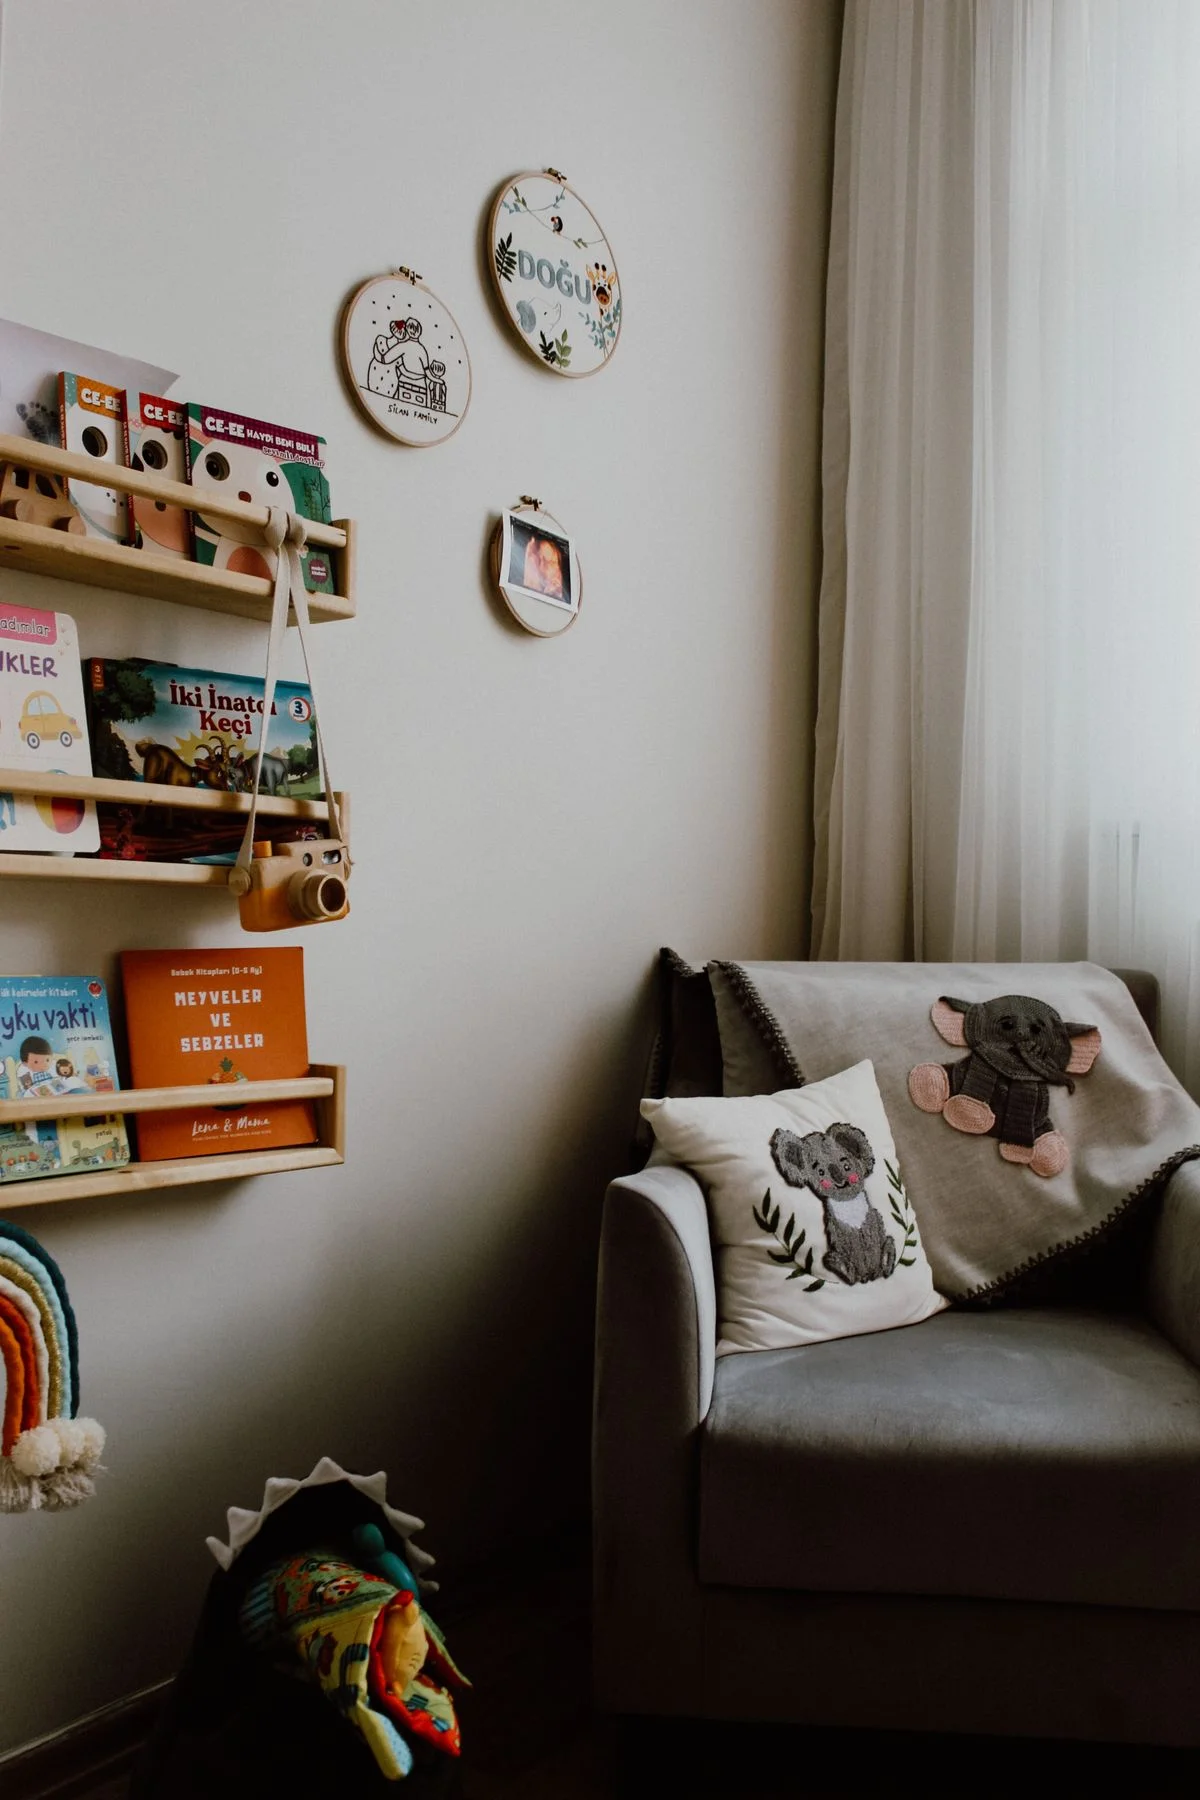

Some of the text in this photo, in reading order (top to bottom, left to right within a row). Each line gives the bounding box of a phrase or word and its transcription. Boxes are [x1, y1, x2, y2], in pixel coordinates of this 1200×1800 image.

[518, 249, 591, 304] DOĞU
[80, 388, 120, 412] CE-EE
[143, 403, 184, 426] CE-EE
[205, 416, 245, 438] CE-EE
[296, 442, 315, 455] BUL!
[169, 678, 203, 708] İki
[294, 700, 303, 714] 3
[199, 710, 252, 739] Keçi
[174, 988, 262, 1007] MEYVELER
[1, 1001, 96, 1040] yku vakti
[210, 1012, 232, 1028] VE
[180, 1033, 264, 1052] SEBZELER
[223, 1117, 232, 1132] &
